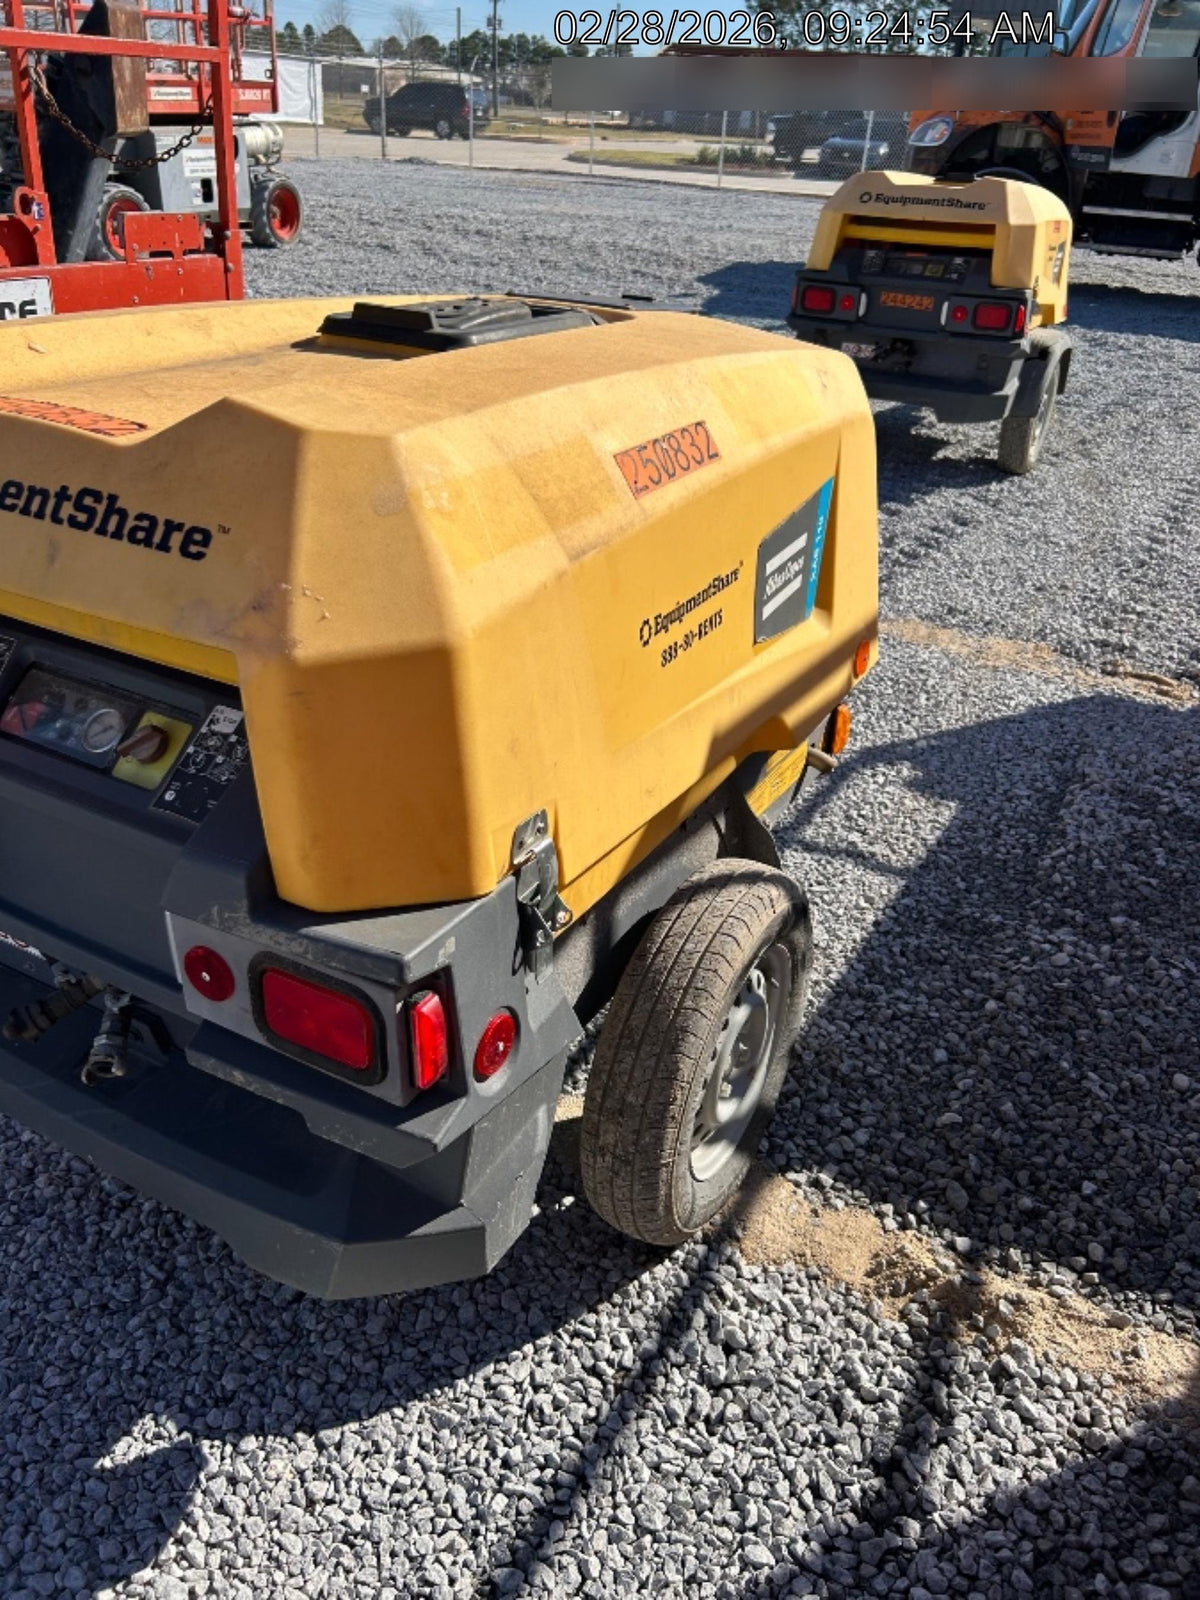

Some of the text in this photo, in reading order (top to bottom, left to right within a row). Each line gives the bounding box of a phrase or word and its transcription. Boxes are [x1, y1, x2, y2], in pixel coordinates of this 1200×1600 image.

[875, 193, 986, 210] EquipmentShare
[620, 421, 719, 494] 250832
[654, 568, 739, 635] EquipmentShare
